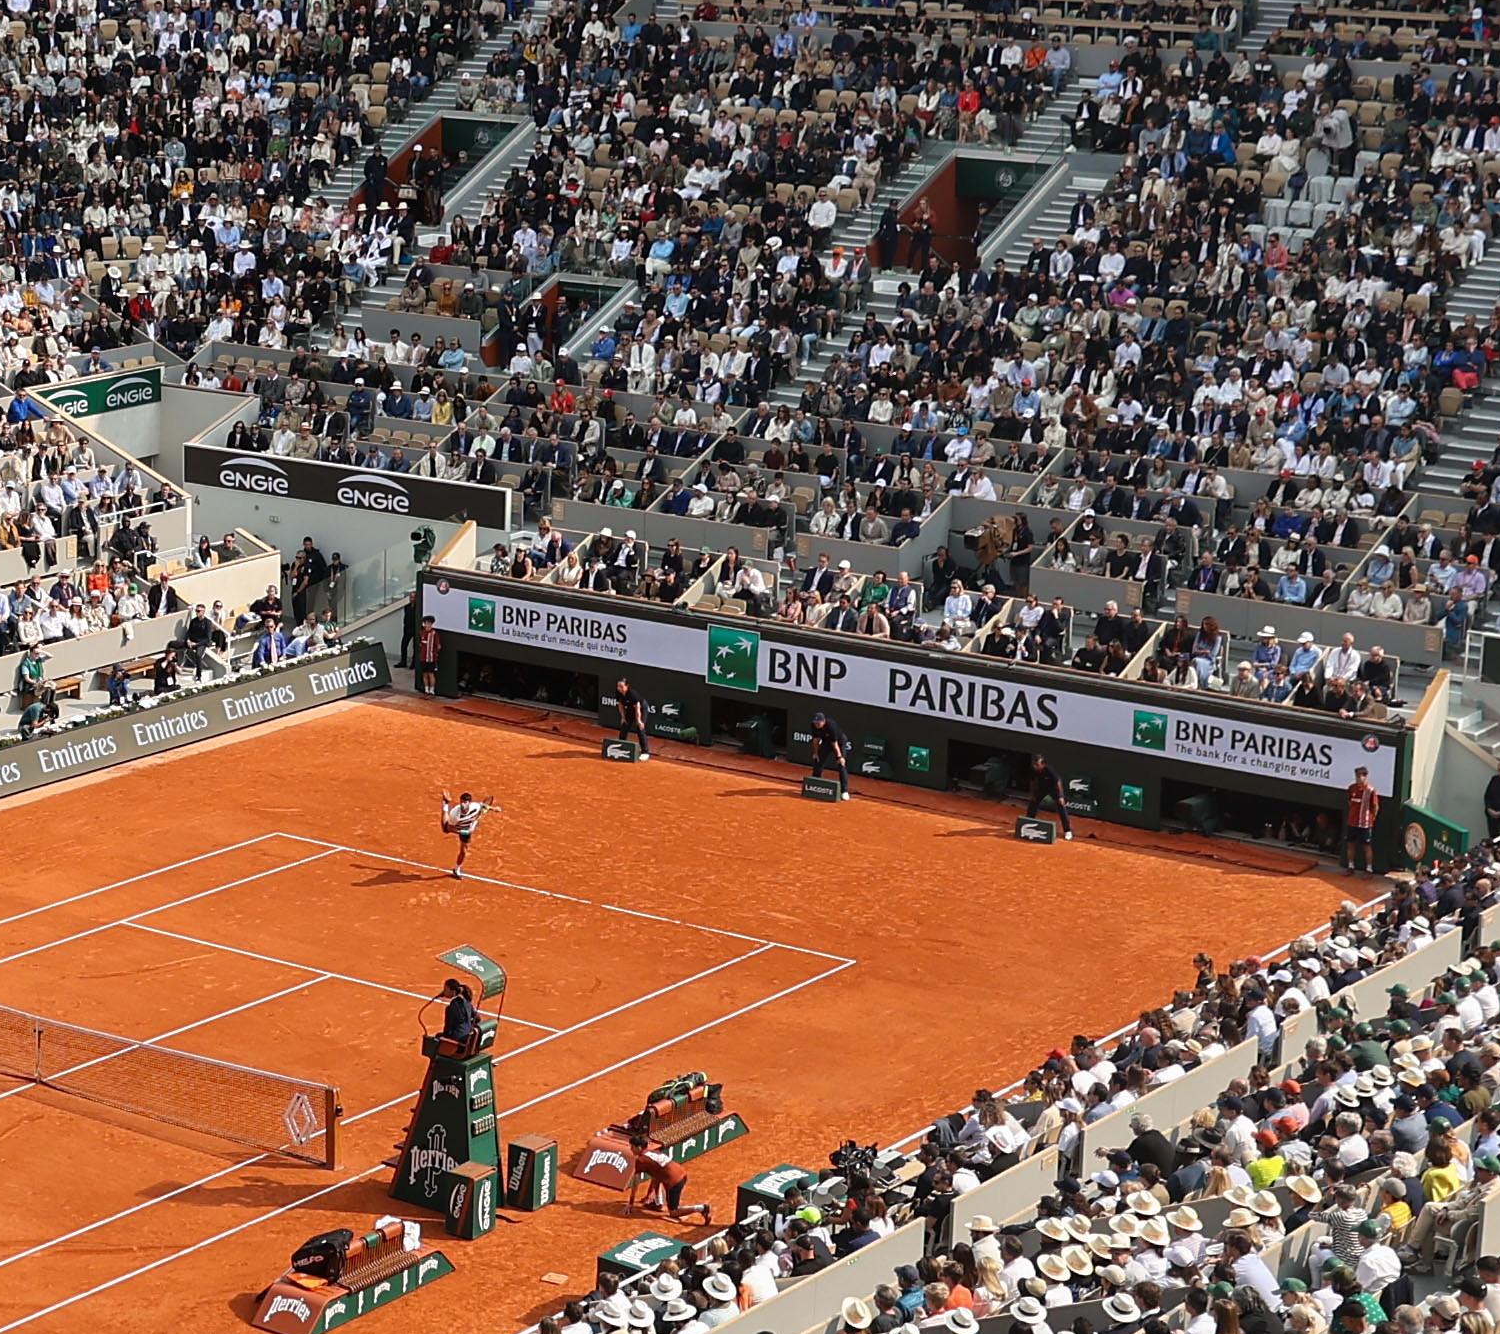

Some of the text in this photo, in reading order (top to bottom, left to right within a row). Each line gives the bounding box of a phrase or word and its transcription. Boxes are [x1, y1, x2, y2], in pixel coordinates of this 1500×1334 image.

[502, 605, 628, 644] BNP PARIBAS
[502, 627, 628, 657] La banque d'un monde qui change
[768, 648, 1059, 731] BNP PARIBAS
[38, 733, 117, 774] Emirates
[132, 706, 209, 748] Emirates
[222, 682, 296, 722] Emirates
[308, 658, 378, 695] Emirates
[793, 732, 812, 743] BNP
[1175, 720, 1333, 767] BNP PARIBAS
[1175, 743, 1193, 756] The
[1196, 746, 1220, 761] bank
[1222, 751, 1238, 765] for
[1250, 755, 1297, 776] changing
[1300, 766, 1331, 780] world
[804, 784, 834, 795] LACOSTE
[1064, 801, 1092, 811] ACOSTE
[1433, 839, 1456, 856] ROLEX
[509, 1151, 528, 1192] Wilson
[540, 1154, 552, 1206] Wilson
